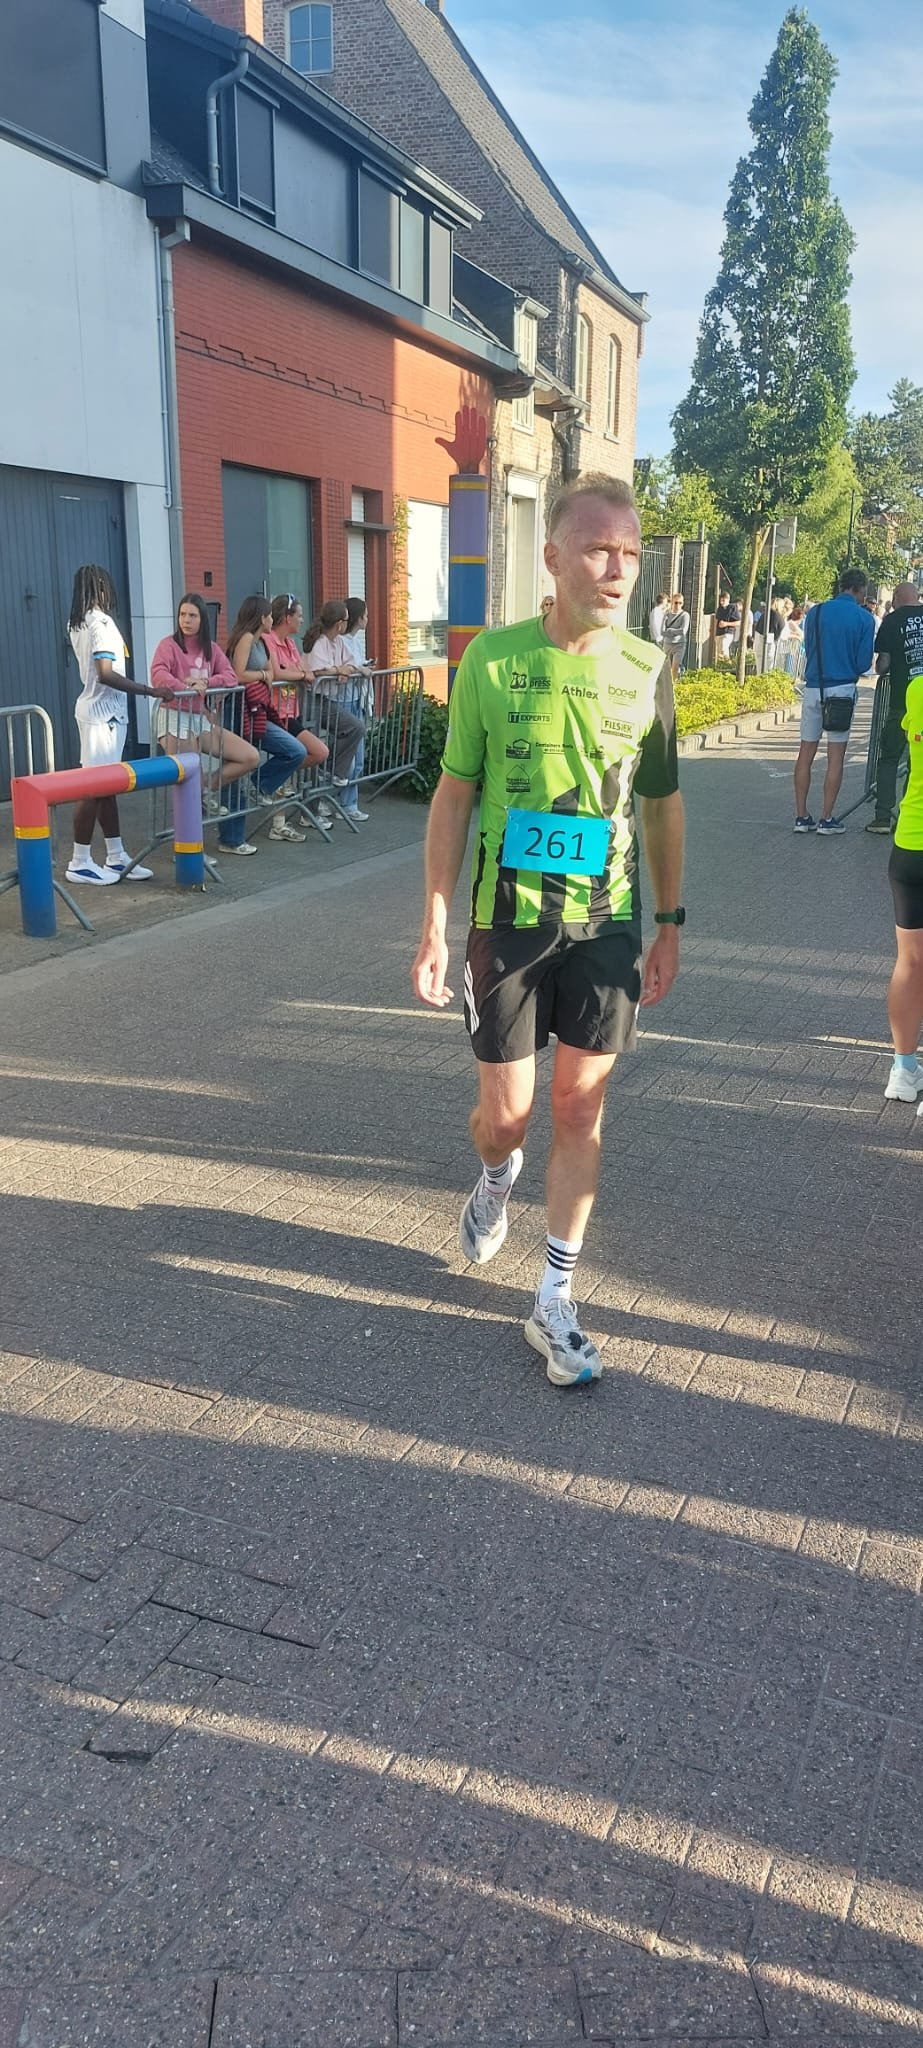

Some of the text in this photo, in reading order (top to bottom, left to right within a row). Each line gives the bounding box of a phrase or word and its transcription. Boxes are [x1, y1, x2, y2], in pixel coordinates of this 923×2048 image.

[620, 650, 653, 673] BIORACER
[561, 685, 599, 700] Athlex
[608, 684, 637, 700] boost
[524, 827, 586, 861] 261
